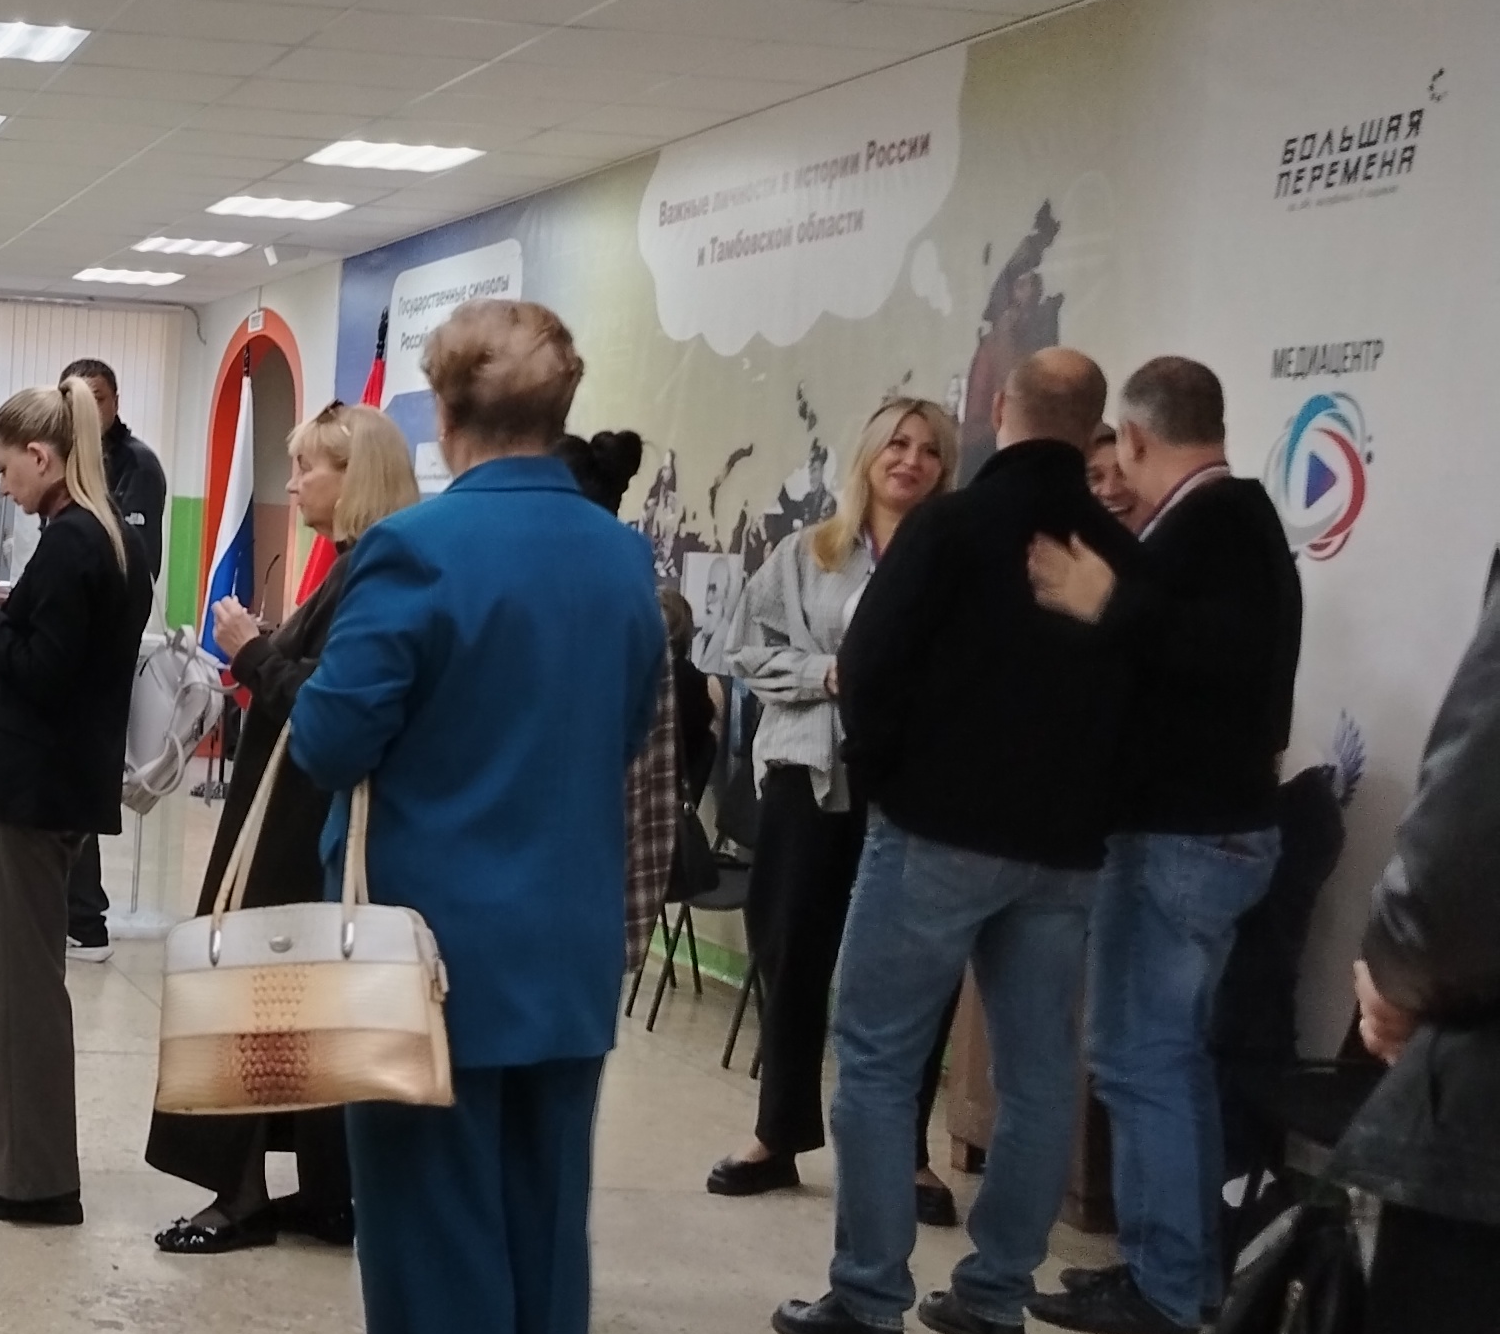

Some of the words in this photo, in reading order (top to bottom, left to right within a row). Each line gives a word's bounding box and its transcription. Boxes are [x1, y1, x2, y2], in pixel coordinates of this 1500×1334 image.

[1281, 108, 1425, 166] БОЛЬШАЯ
[659, 195, 710, 227] Важные
[794, 151, 860, 190] истории
[864, 131, 932, 172] России
[1274, 144, 1418, 199] ПЕРЕМЕНА
[697, 245, 705, 267] и
[710, 217, 793, 264] Тамбовской
[796, 207, 864, 244] области
[398, 284, 467, 319] Государственные
[468, 274, 510, 299] символы
[1270, 338, 1385, 380] МЕДИАЦЕНТР
